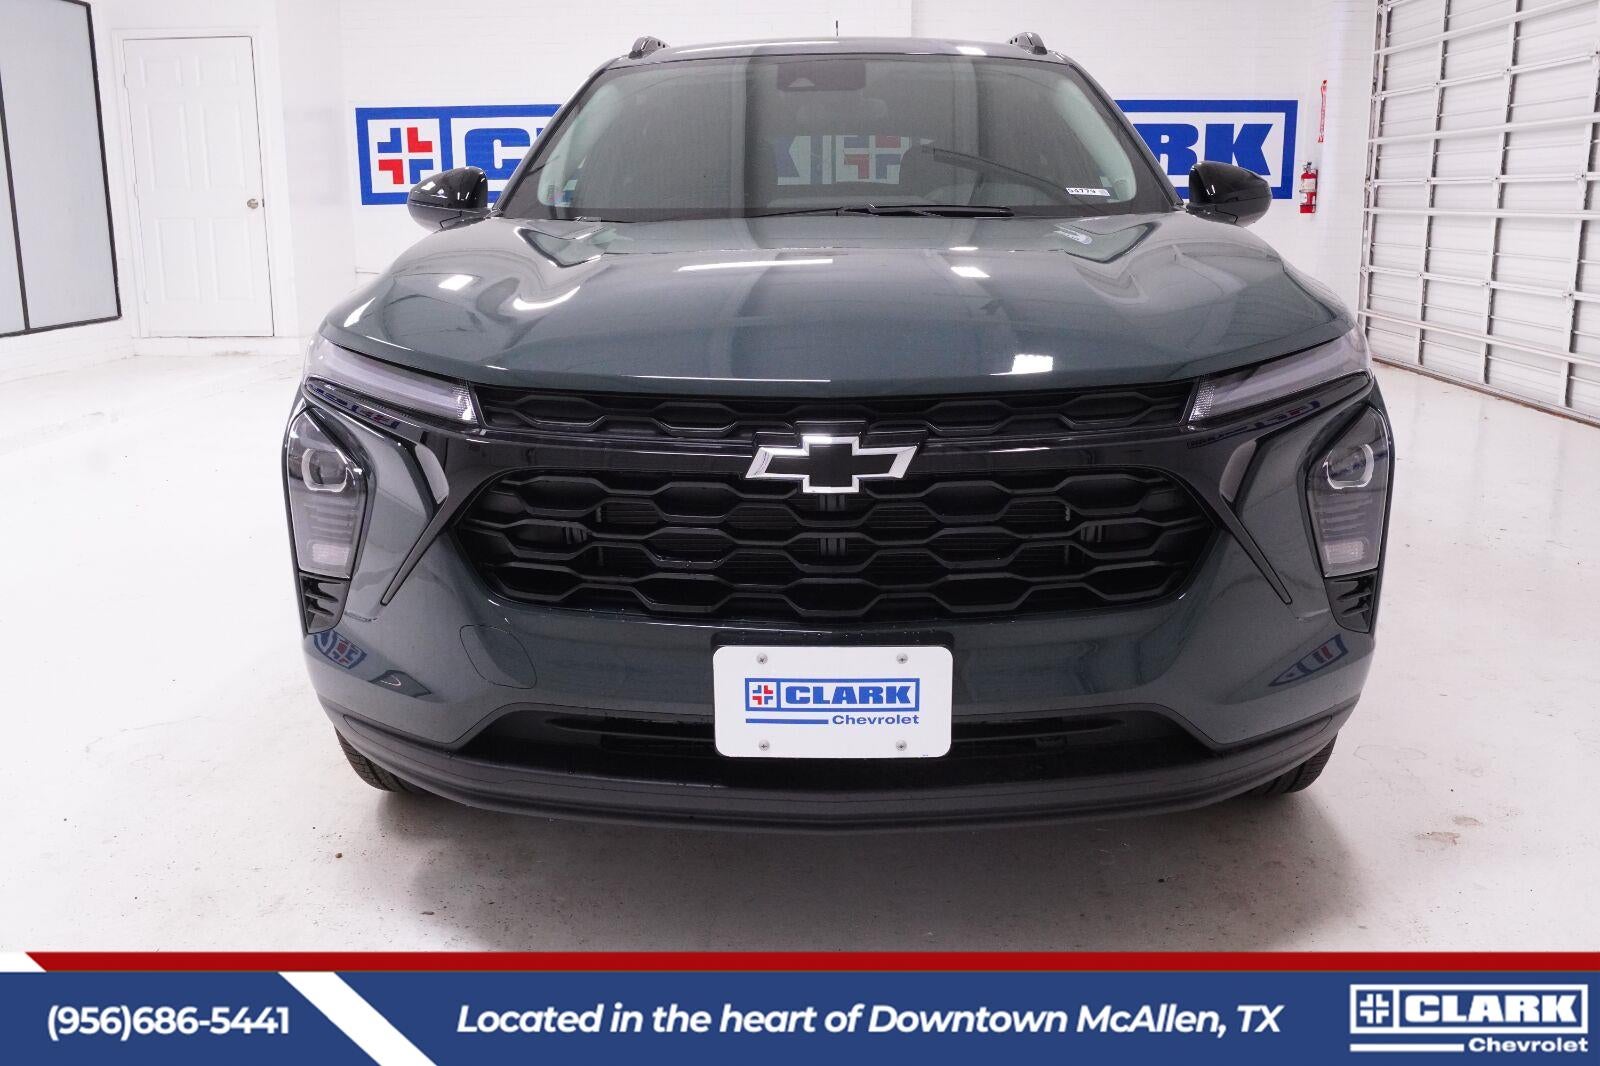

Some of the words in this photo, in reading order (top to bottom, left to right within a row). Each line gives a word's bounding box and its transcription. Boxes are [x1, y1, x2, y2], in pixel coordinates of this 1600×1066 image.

[464, 127, 541, 180] C
[785, 685, 911, 705] CLARK
[832, 714, 919, 725] Chevrolet
